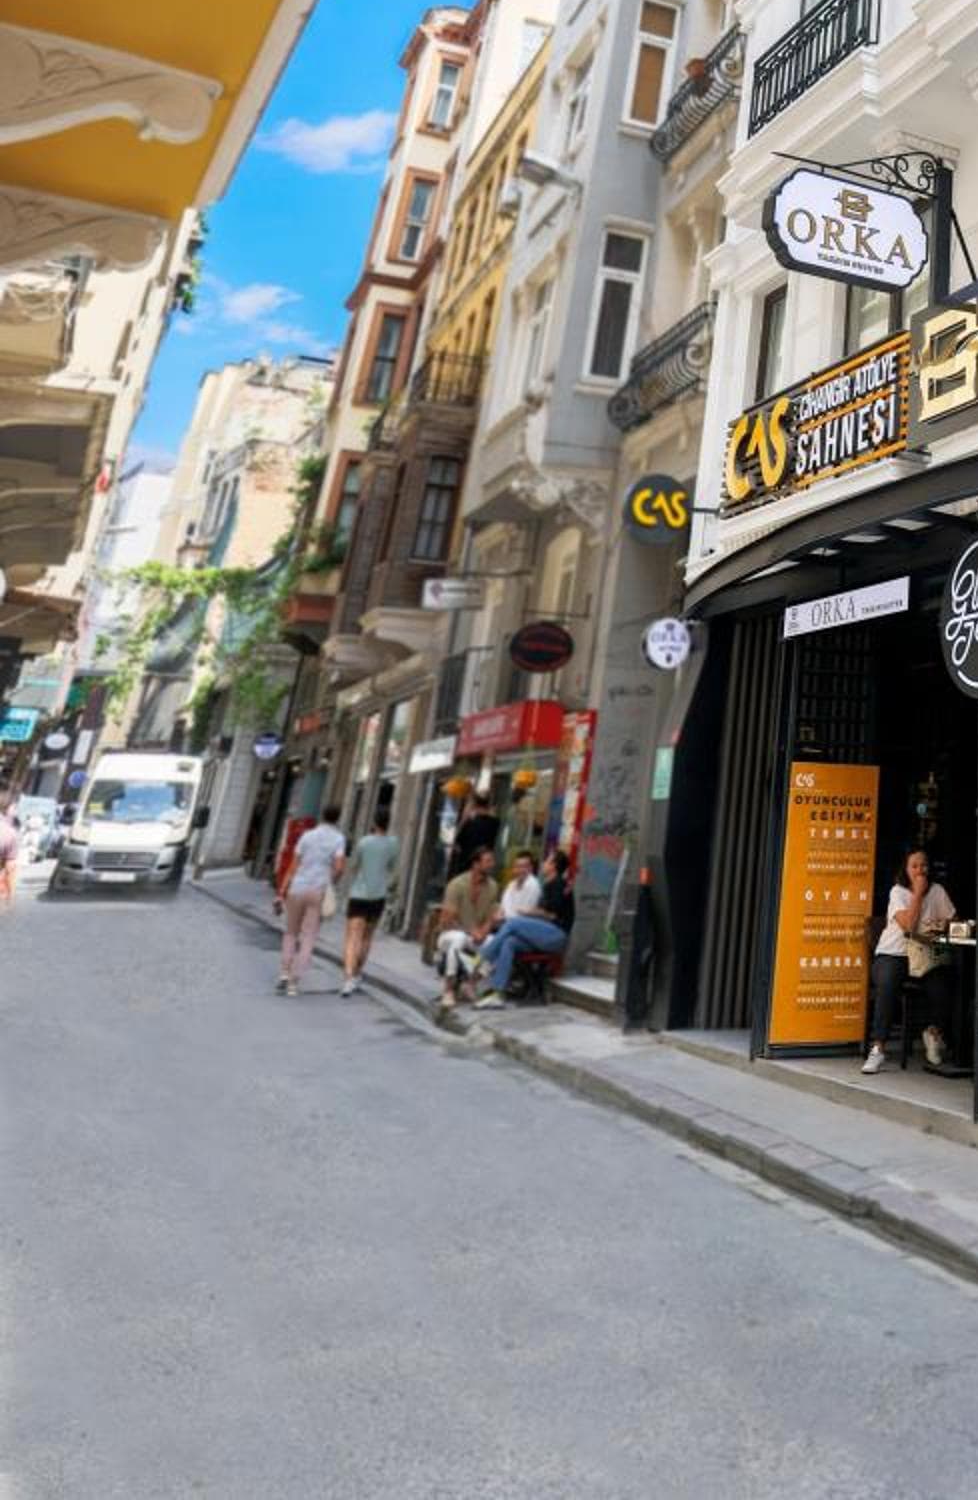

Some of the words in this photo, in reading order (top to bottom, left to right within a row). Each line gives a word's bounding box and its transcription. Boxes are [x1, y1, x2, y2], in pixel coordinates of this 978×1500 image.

[787, 208, 914, 270] ORKA
[799, 372, 850, 422] CİHANGİR
[853, 351, 898, 398] ATÖLYE
[795, 384, 897, 476] SAHNESİ
[811, 596, 857, 627] ORKA
